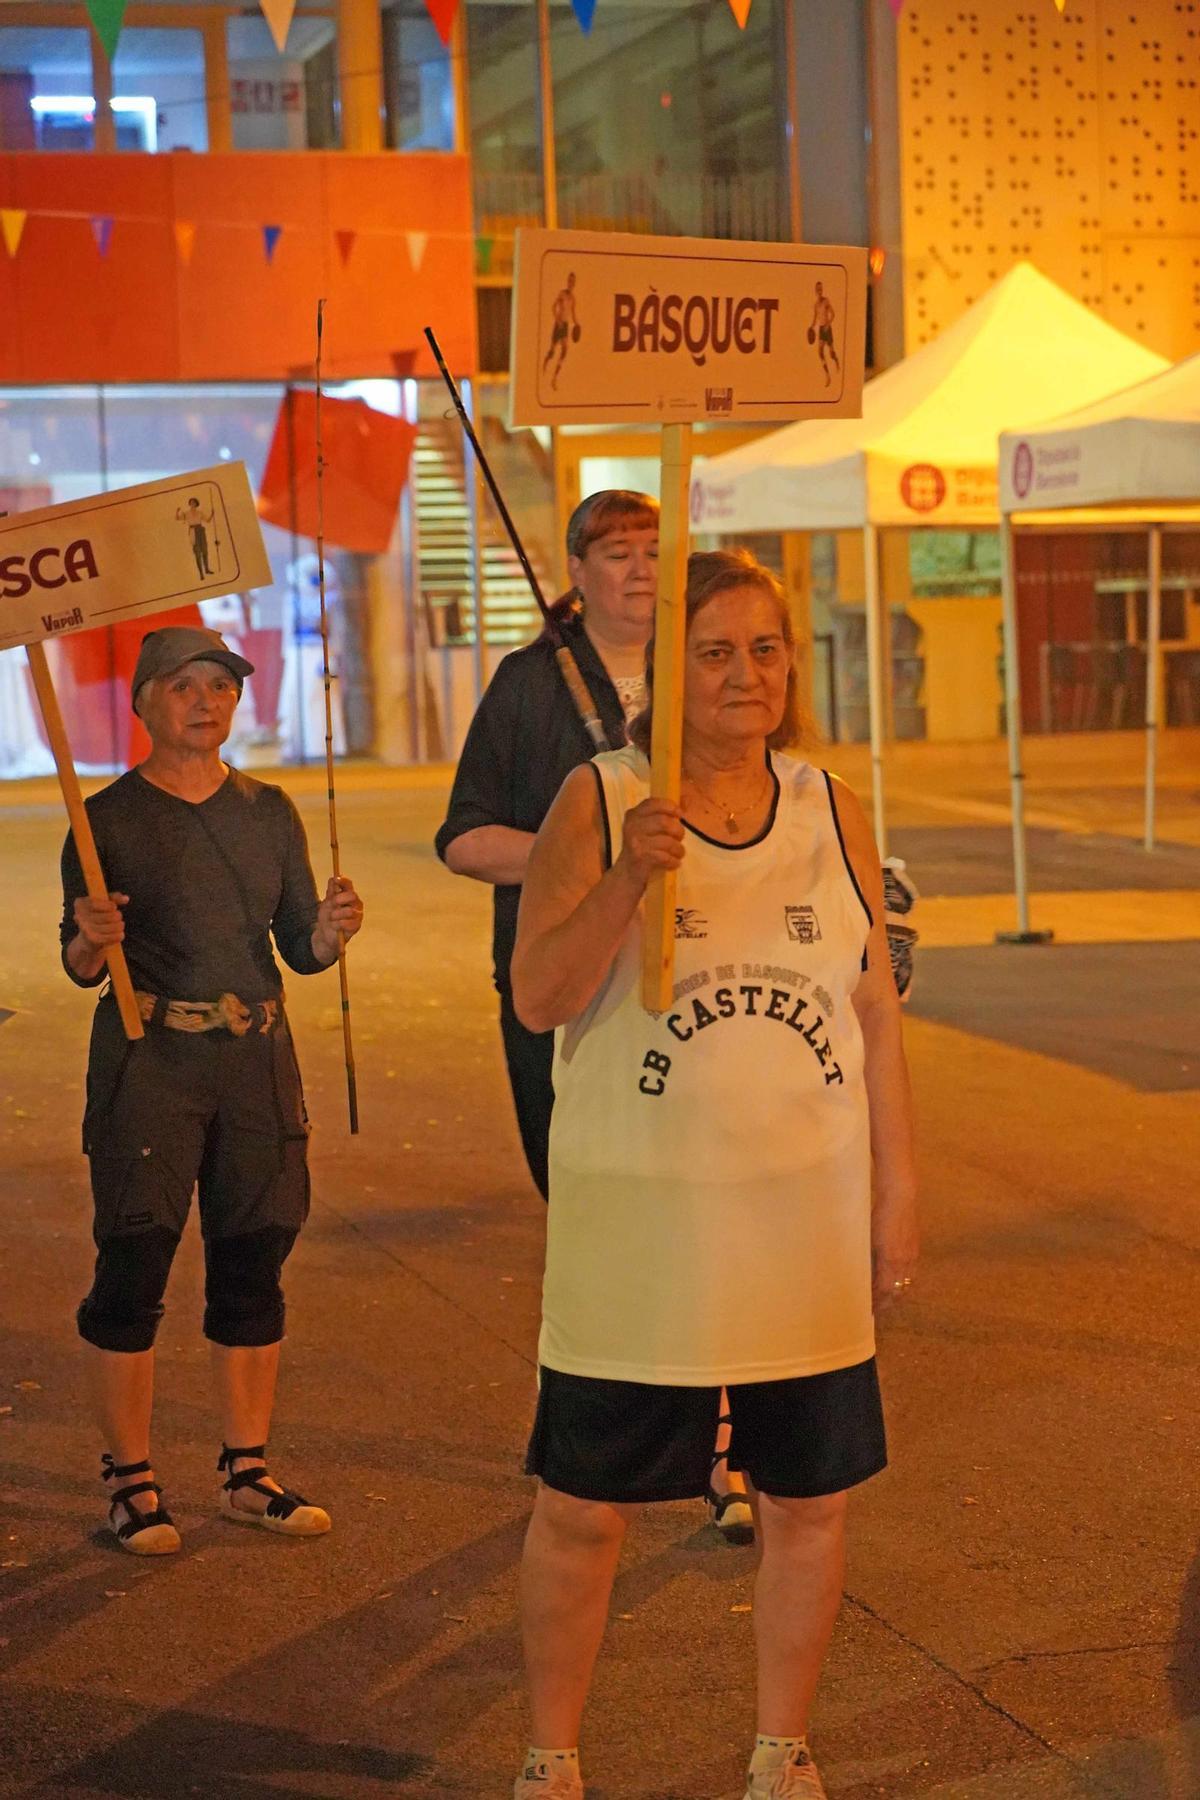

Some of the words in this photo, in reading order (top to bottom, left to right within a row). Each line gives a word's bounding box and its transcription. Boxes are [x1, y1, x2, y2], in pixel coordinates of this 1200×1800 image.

[612, 285, 779, 367] BÀSQUET
[0, 538, 100, 599] SCA
[638, 1049, 672, 1096] CB
[667, 985, 843, 1086] CASTELLET
